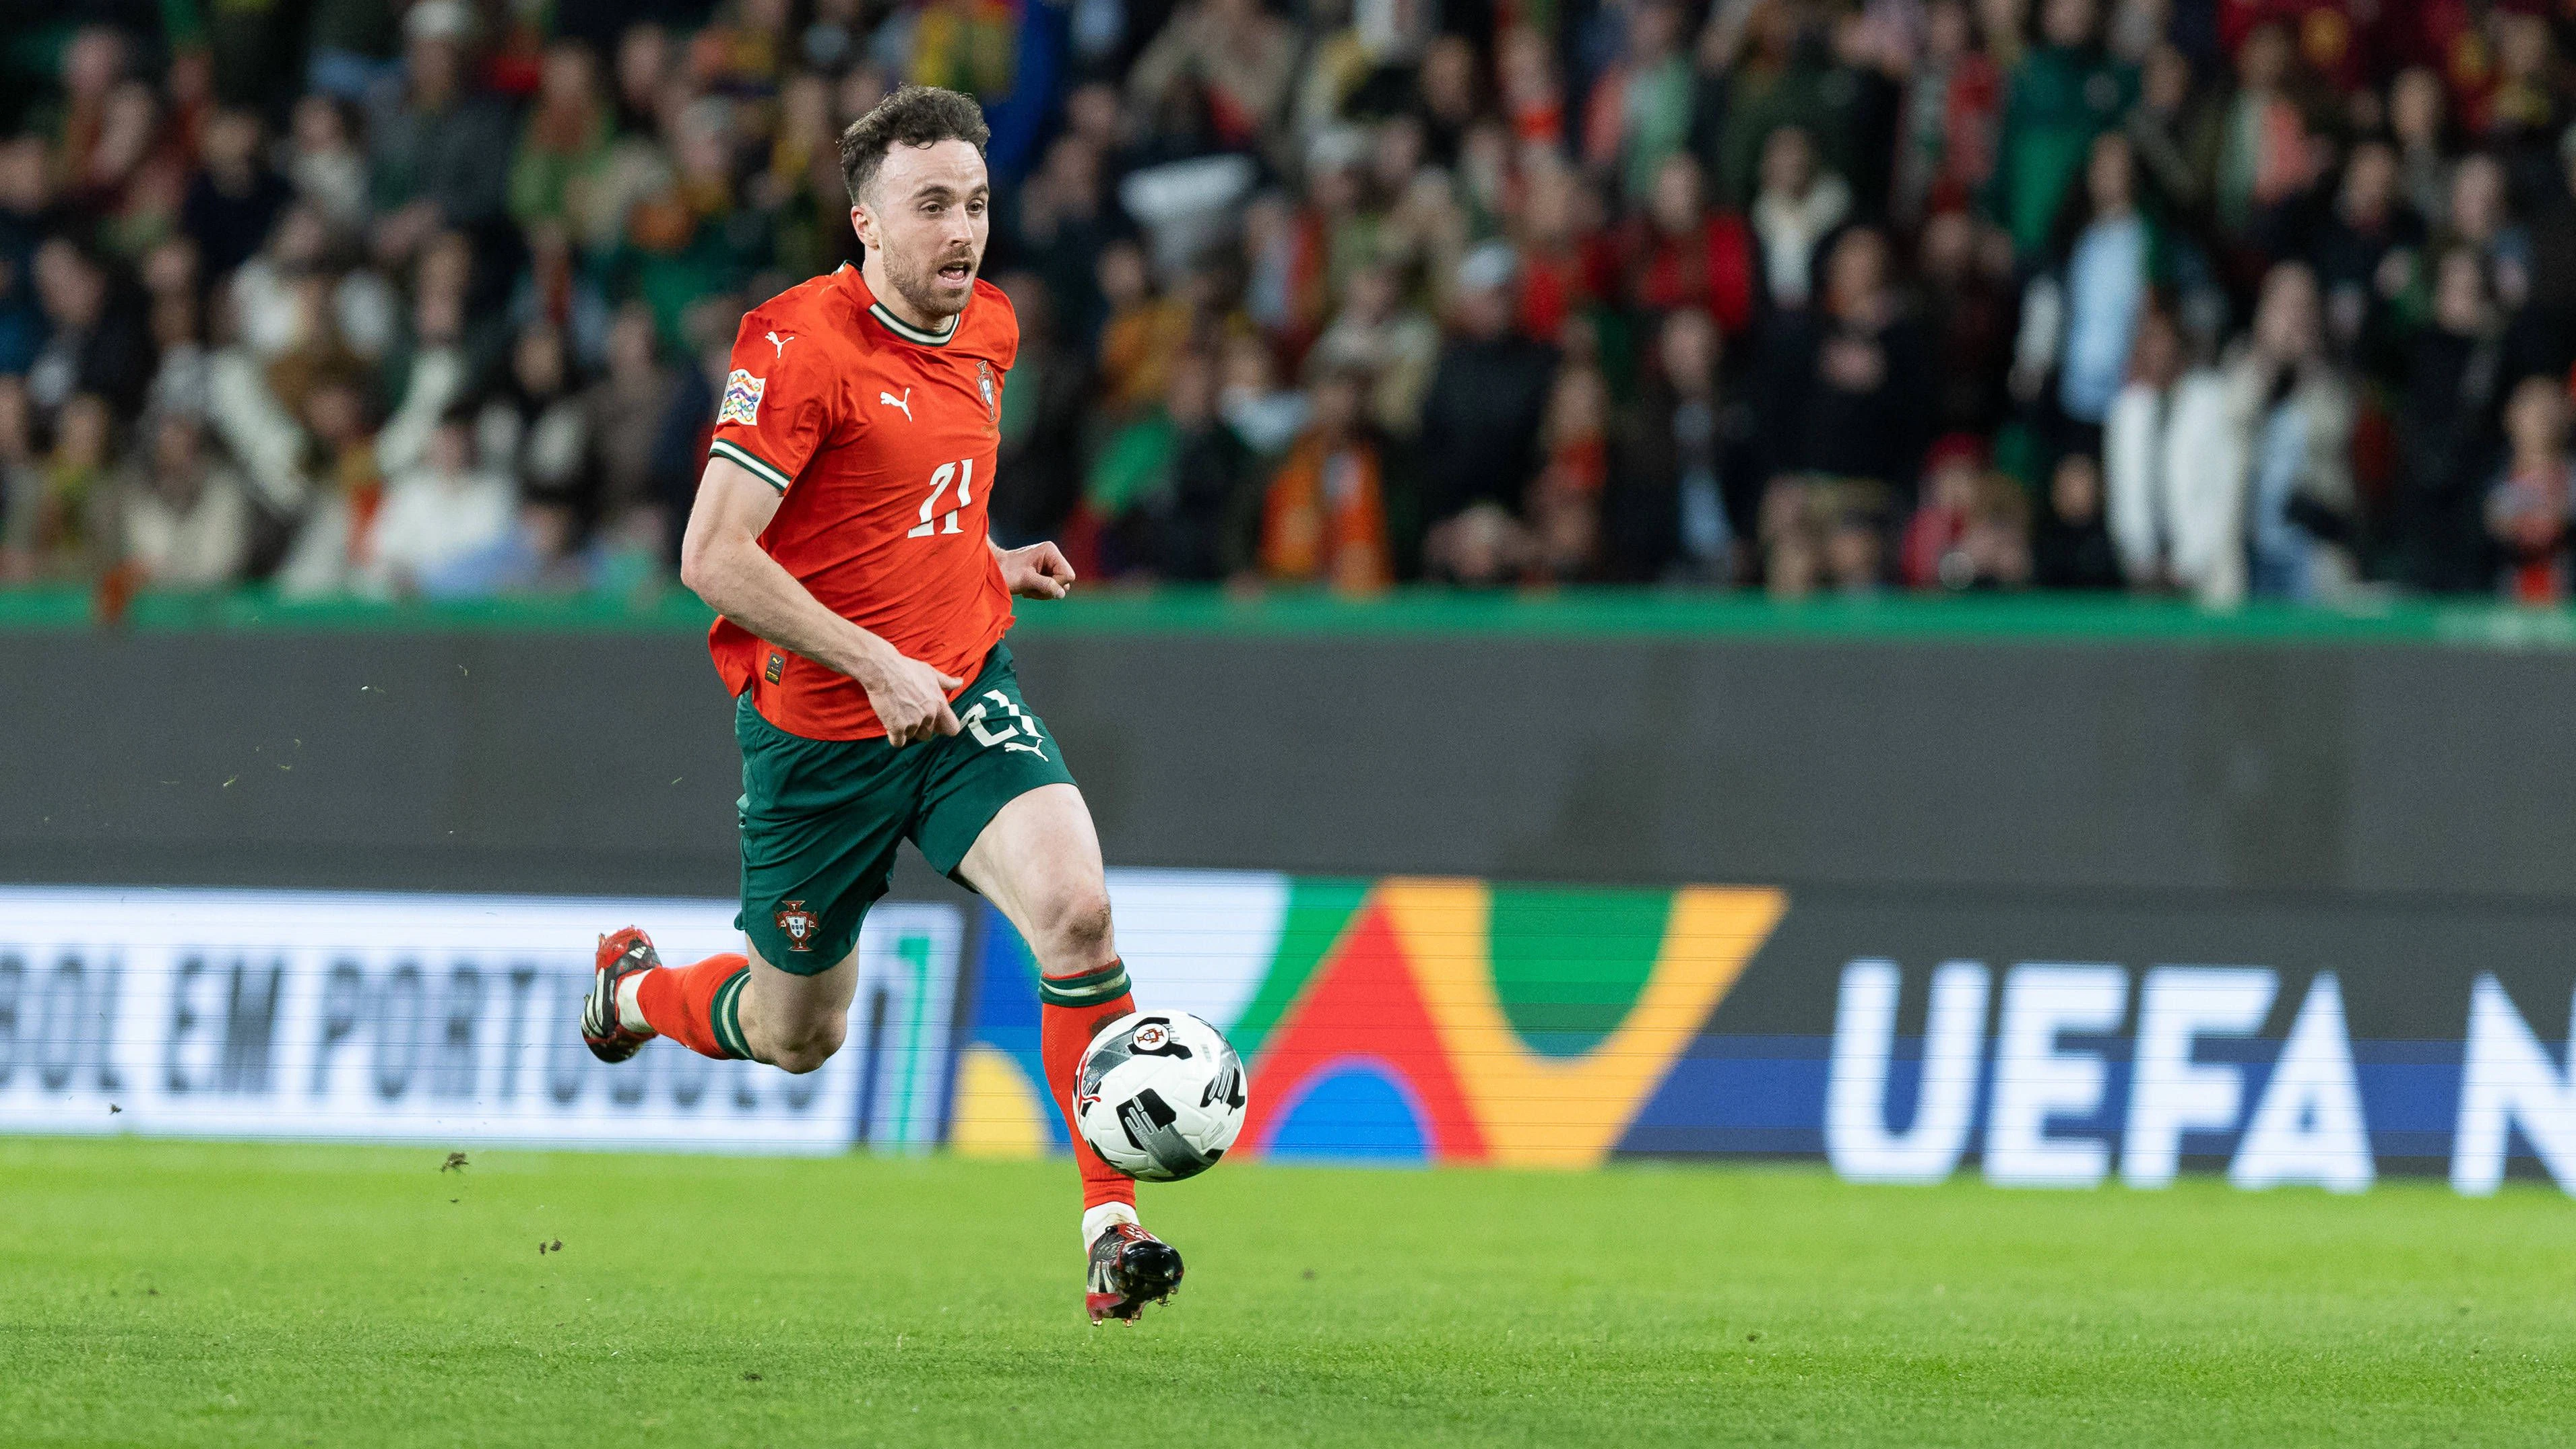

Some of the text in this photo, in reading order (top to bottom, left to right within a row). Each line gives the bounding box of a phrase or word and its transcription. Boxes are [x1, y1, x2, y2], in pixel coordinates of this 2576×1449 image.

[907, 458, 973, 539] 21
[959, 688, 1046, 747] 21
[164, 952, 286, 1097] EM
[307, 957, 825, 1113] PORTU
[1823, 957, 2576, 1198] UEFA N
